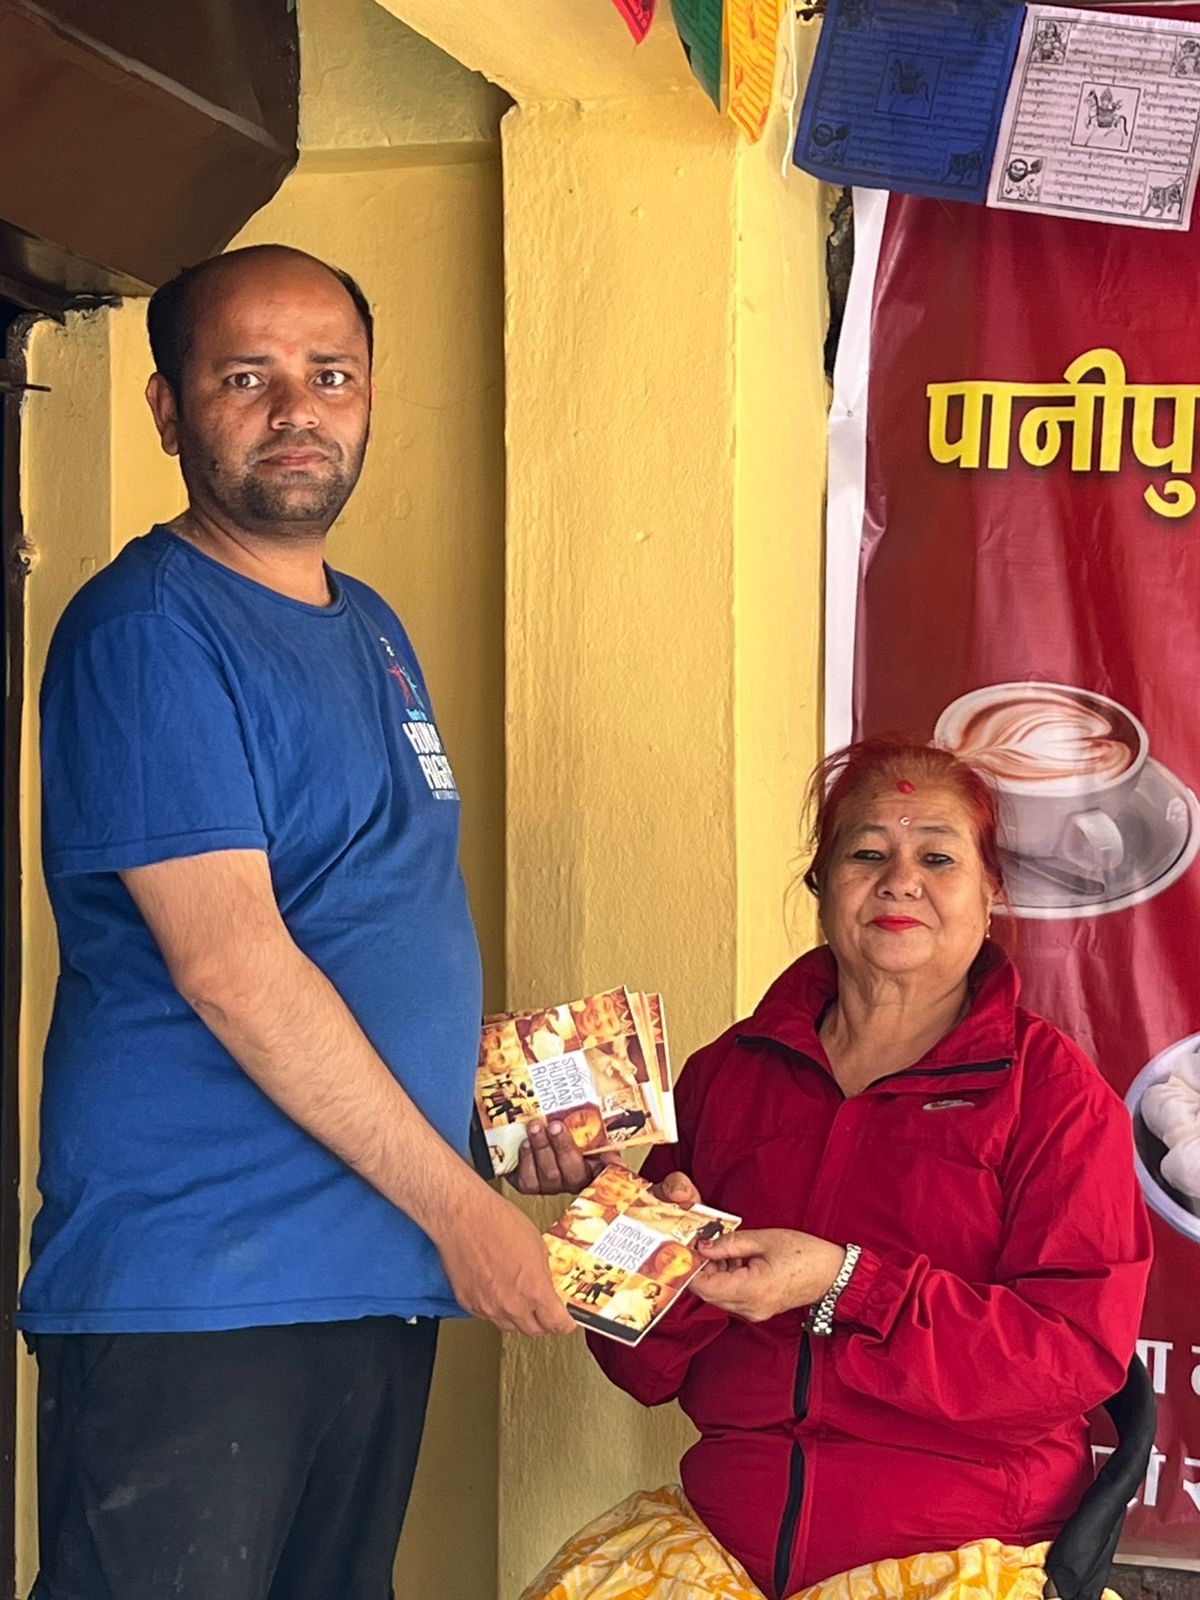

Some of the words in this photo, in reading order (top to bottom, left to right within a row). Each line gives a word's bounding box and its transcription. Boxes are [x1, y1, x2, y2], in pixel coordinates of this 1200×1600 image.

[926, 348, 1200, 518] पानीपु
[531, 1065, 558, 1111] RIGHTS
[547, 1060, 573, 1106] HUMAN
[562, 1057, 581, 1088] STORY
[572, 1088, 587, 1101] OF
[602, 1231, 649, 1258] HUMAN
[613, 1222, 645, 1241] STORY
[593, 1243, 640, 1271] RIGHTS
